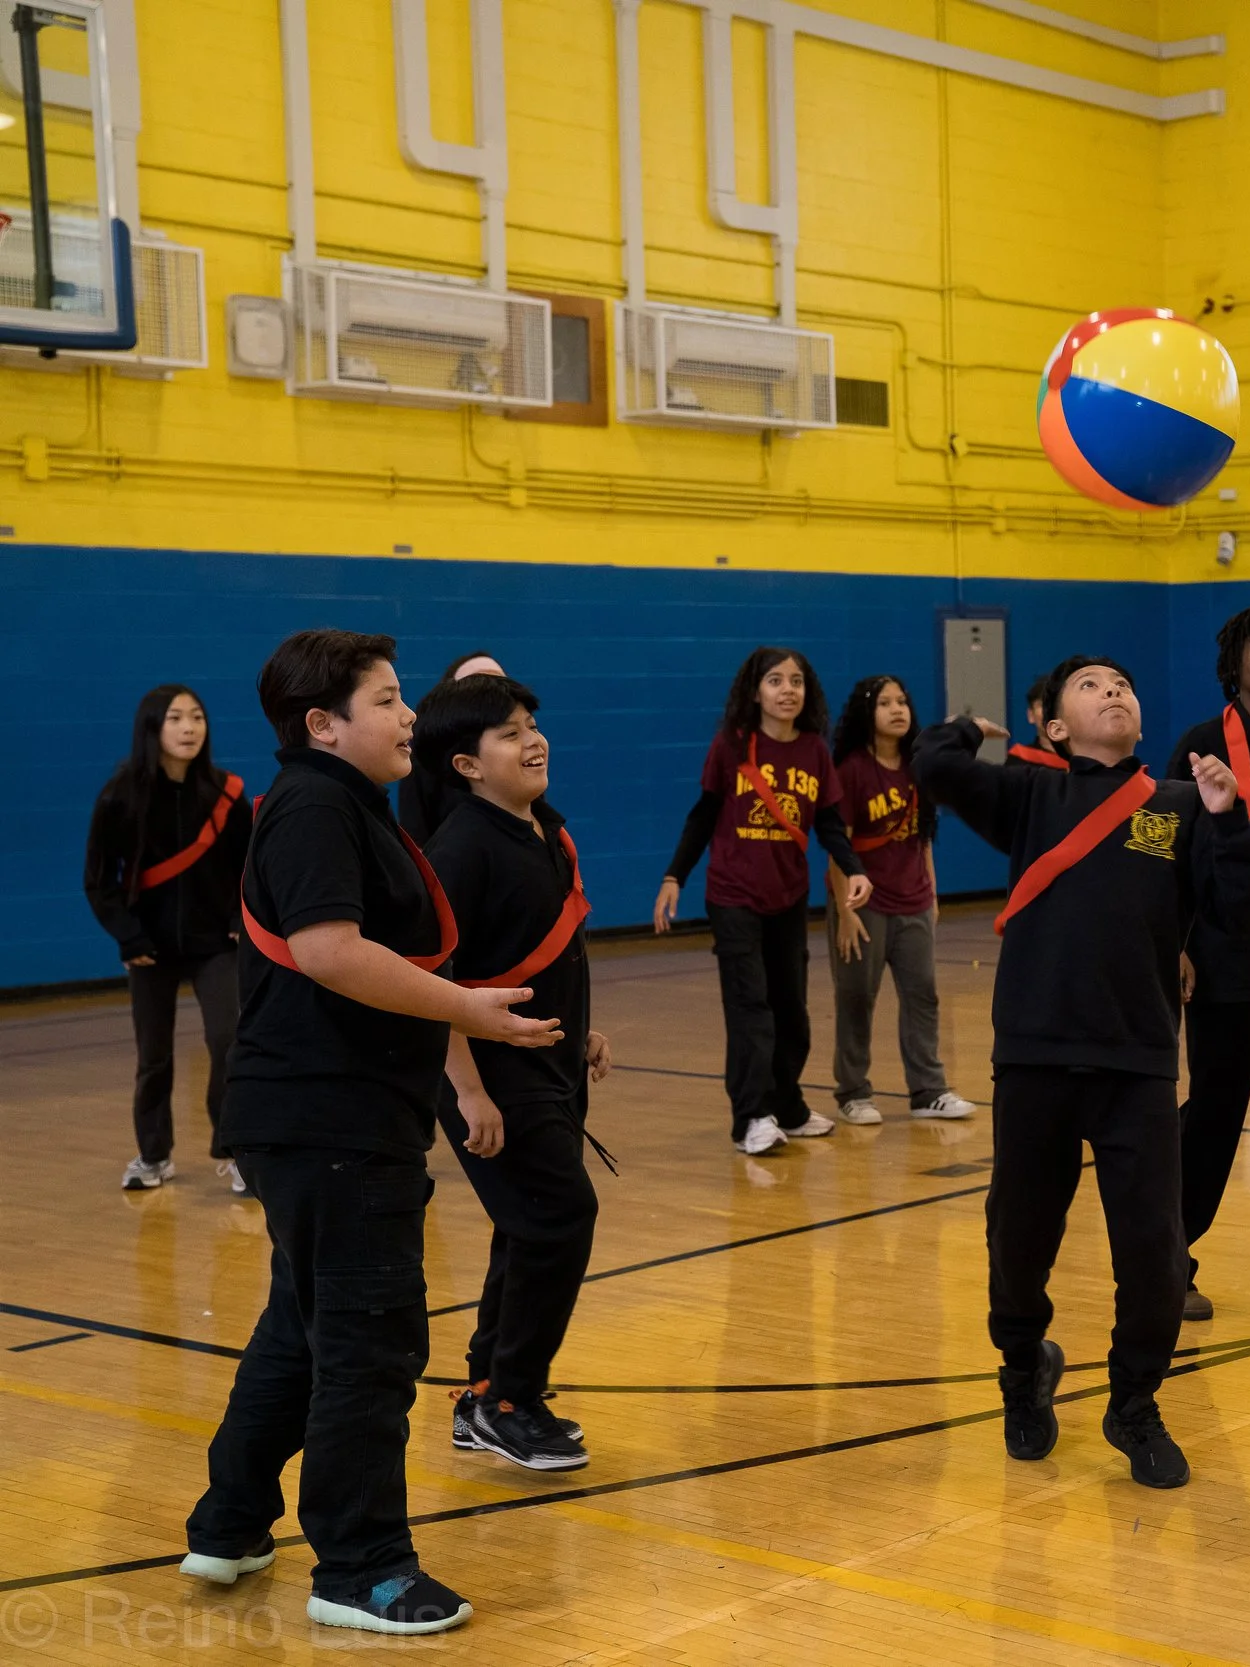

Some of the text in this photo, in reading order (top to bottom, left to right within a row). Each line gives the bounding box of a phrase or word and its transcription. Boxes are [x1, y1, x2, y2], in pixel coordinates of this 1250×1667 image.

[736, 763, 819, 803] MS. 136
[868, 786, 907, 823] M.S.
